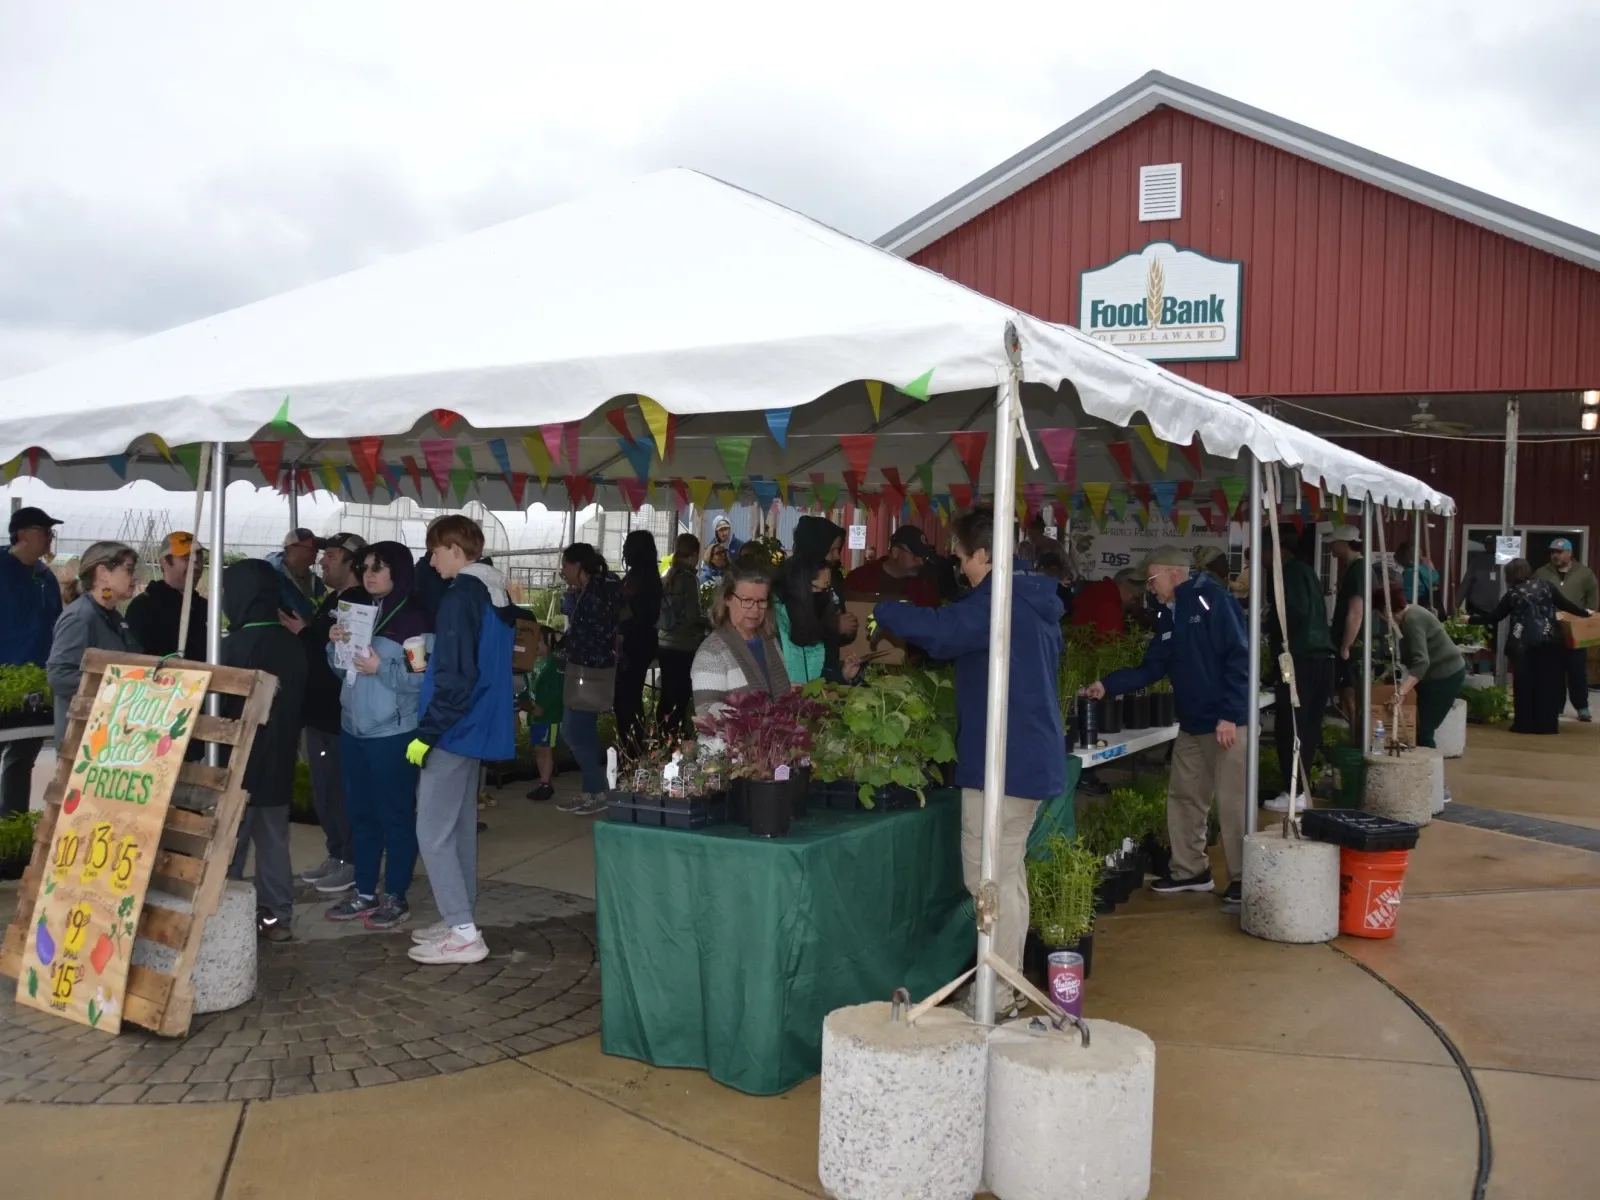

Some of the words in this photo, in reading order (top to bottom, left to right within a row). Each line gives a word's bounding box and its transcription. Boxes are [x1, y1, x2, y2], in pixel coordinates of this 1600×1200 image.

[1090, 298, 1148, 328] Food
[1160, 294, 1225, 325] Bank
[1098, 334, 1117, 343] OF
[1128, 330, 1217, 342] DELAWARE
[109, 679, 184, 729] Plant
[96, 724, 151, 766] Sale
[82, 767, 154, 804] PRICES
